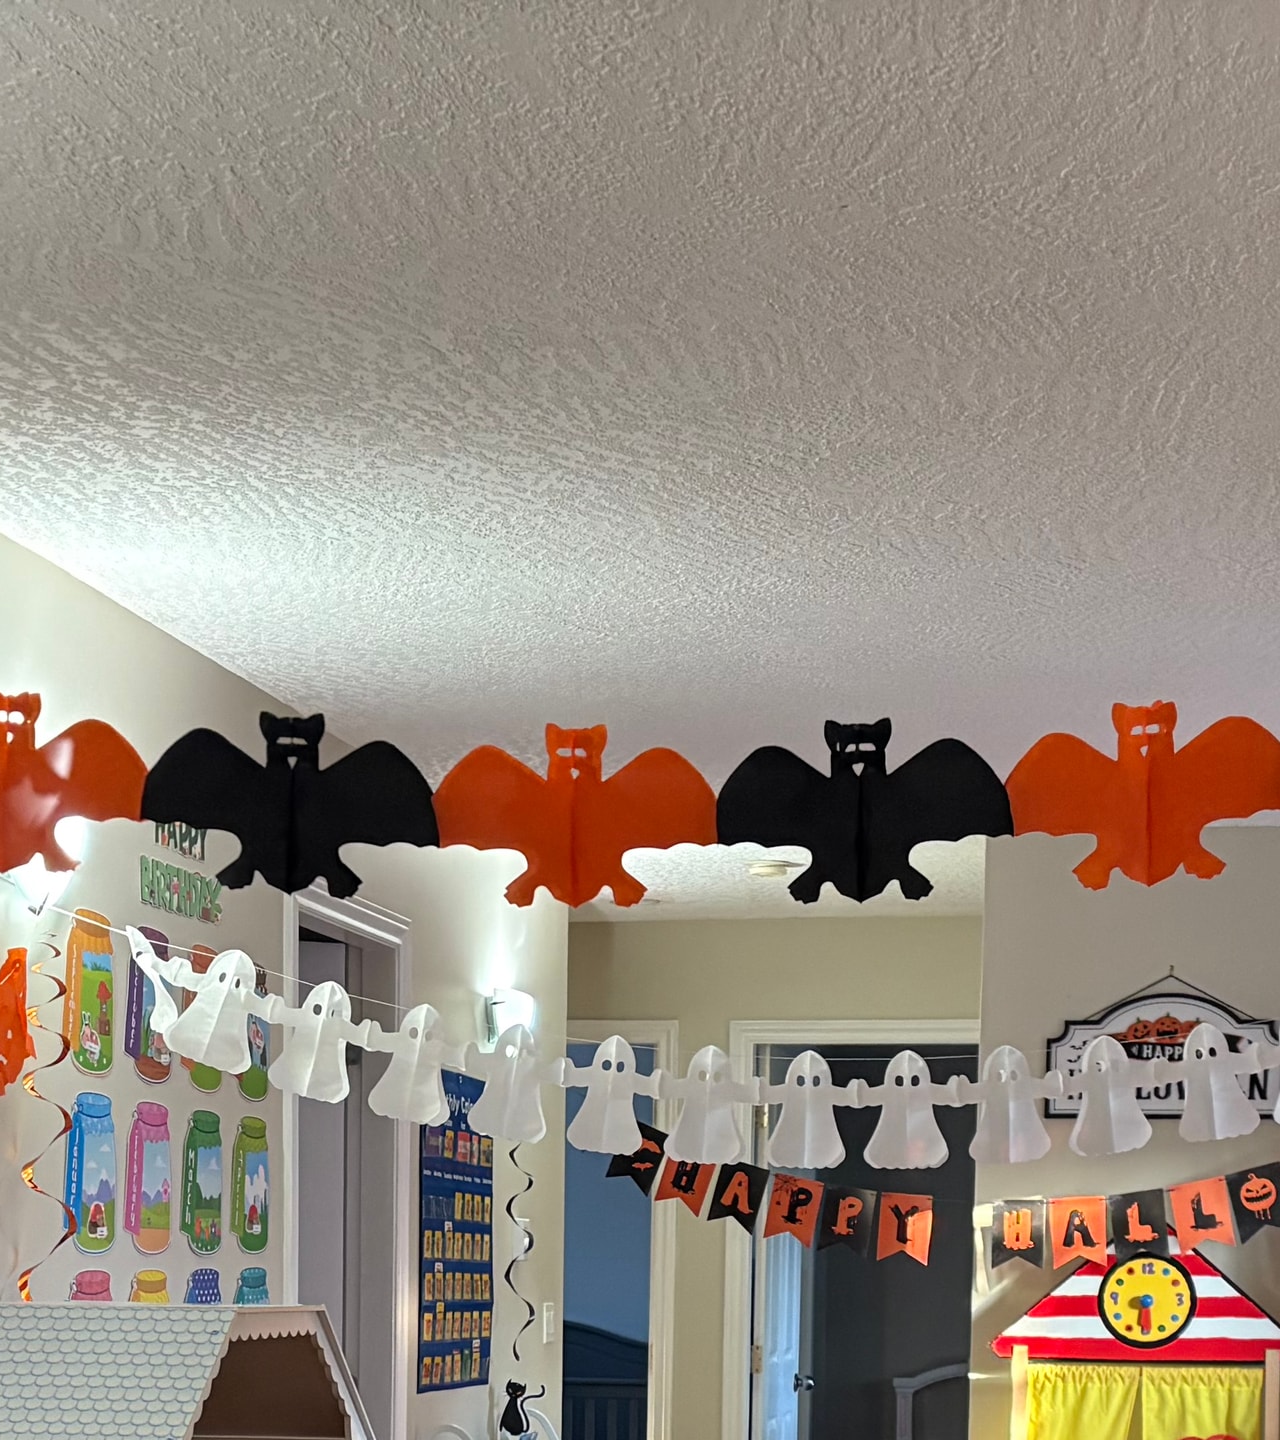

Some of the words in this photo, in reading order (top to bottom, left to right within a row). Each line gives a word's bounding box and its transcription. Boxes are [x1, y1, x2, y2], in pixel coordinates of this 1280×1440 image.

[140, 854, 222, 922] BIRTHDAY
[1143, 1044, 1184, 1060] HAPP
[185, 1148, 195, 1225] March
[1175, 1292, 1185, 1307] 3
